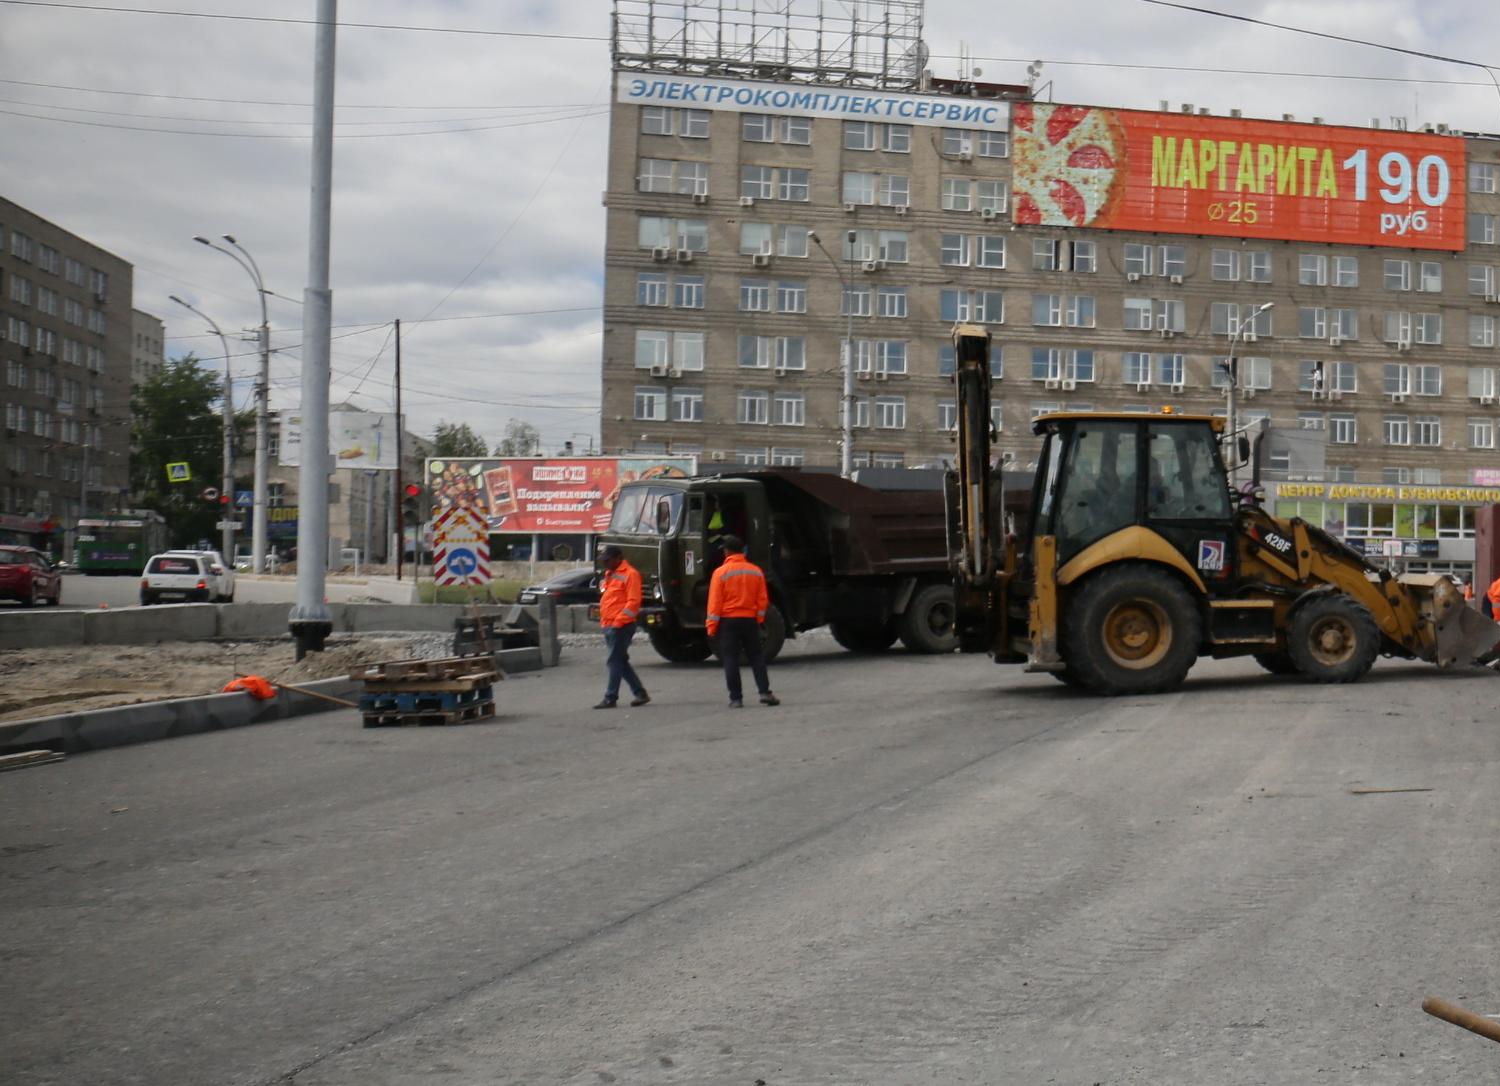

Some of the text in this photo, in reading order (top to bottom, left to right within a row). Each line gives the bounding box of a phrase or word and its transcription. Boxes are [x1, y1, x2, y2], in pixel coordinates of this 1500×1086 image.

[629, 79, 998, 124] ЭЛЕКТРОКОМПЛЕКТСЕРВИС
[1151, 136, 1449, 206] МАРГАРИТА 190
[1380, 210, 1428, 235] руб
[1277, 484, 1324, 497] ЦЕНТР
[1328, 485, 1395, 499] ДОКТОРА
[1264, 533, 1291, 552] 428F
